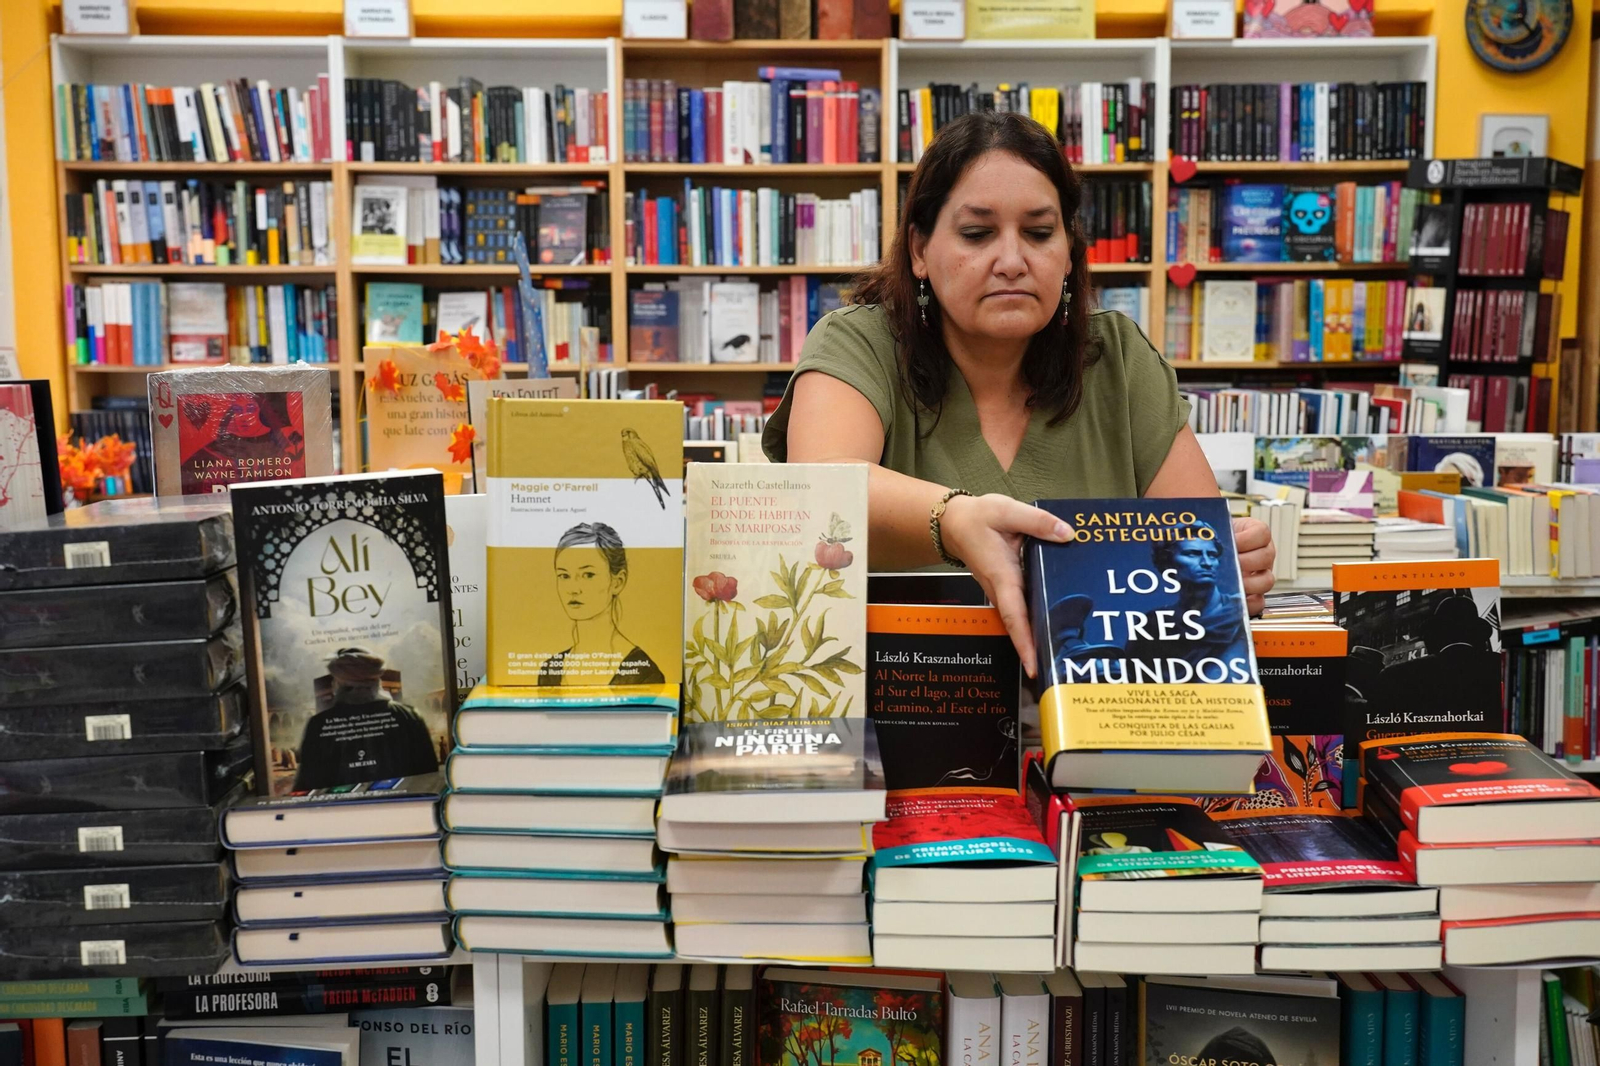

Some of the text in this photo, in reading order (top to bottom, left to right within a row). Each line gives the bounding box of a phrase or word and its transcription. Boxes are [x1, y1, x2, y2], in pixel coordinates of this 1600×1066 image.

[400, 373, 418, 387] UZ
[157, 382, 174, 408] Q
[194, 457, 292, 469] LIANA ROMERO
[194, 468, 292, 479] WAYNE JAMISON
[511, 483, 598, 493] Maggie O'Farrell
[711, 480, 811, 490] Nazareth Castellanos
[252, 493, 428, 516] ANTONIO TORREMOCHA SILVA
[511, 494, 551, 504] Hamnet
[711, 496, 778, 506] EL PUENTE
[711, 510, 811, 520] DONDE HABITAN
[1075, 511, 1197, 527] SANTIAGO
[710, 524, 801, 533] LAS MARIPOSAS
[1074, 528, 1216, 543] OSTEGUILLO
[320, 533, 370, 575] Alí
[1106, 568, 1182, 594] LOS
[1373, 572, 1466, 580] ACANTILADO
[307, 576, 392, 618] Bey
[1092, 609, 1206, 641] TRES
[564, 652, 590, 660] Maggie
[875, 651, 992, 665] László Krasznahorkai
[622, 660, 650, 668] español,
[1062, 657, 1250, 684] MUNDOS
[616, 668, 640, 676] Agustí.
[875, 669, 996, 684] Al Norte la montaña,
[874, 685, 1001, 701] al Sur el lago, al Oeste
[874, 701, 1006, 714] el camino, al Este el río
[1072, 696, 1095, 705] MÁS
[1206, 698, 1255, 706] HISTORIA
[1366, 711, 1484, 725] László Krasznahorkai
[714, 733, 842, 747] NINGUNA
[735, 743, 819, 756] PARTE
[1252, 818, 1333, 827] Krasznahorkai
[911, 844, 963, 854] PREMIO
[915, 847, 994, 858] LITERATURA
[1000, 847, 1034, 855] 2025
[1280, 865, 1322, 873] PREMIO
[1286, 870, 1363, 879] LITERATURA
[322, 984, 416, 1006] FREIDA McFADDEN
[195, 992, 278, 1013] LA PROFESORA
[780, 997, 917, 1021] Rafael Tarradas Bultó
[1179, 1006, 1206, 1015] PREMIO
[1218, 1010, 1247, 1018] NOVELA
[1249, 1013, 1278, 1021] ATENEO
[1291, 1015, 1317, 1023] SEVILLA
[410, 1022, 471, 1035] DEL RÍO
[661, 1006, 671, 1049] ÁLVAREZ
[698, 1006, 708, 1048] ÁLVAREZ
[733, 1006, 743, 1048] ÁLVAREZ
[592, 1025, 600, 1055] MARIO
[978, 1022, 992, 1061] ANA
[1026, 1019, 1040, 1058] ANA
[191, 1053, 205, 1061] Esta
[229, 1056, 251, 1065] lección
[387, 1047, 415, 1066] EL
[1169, 1052, 1216, 1066] ÓSCAR
